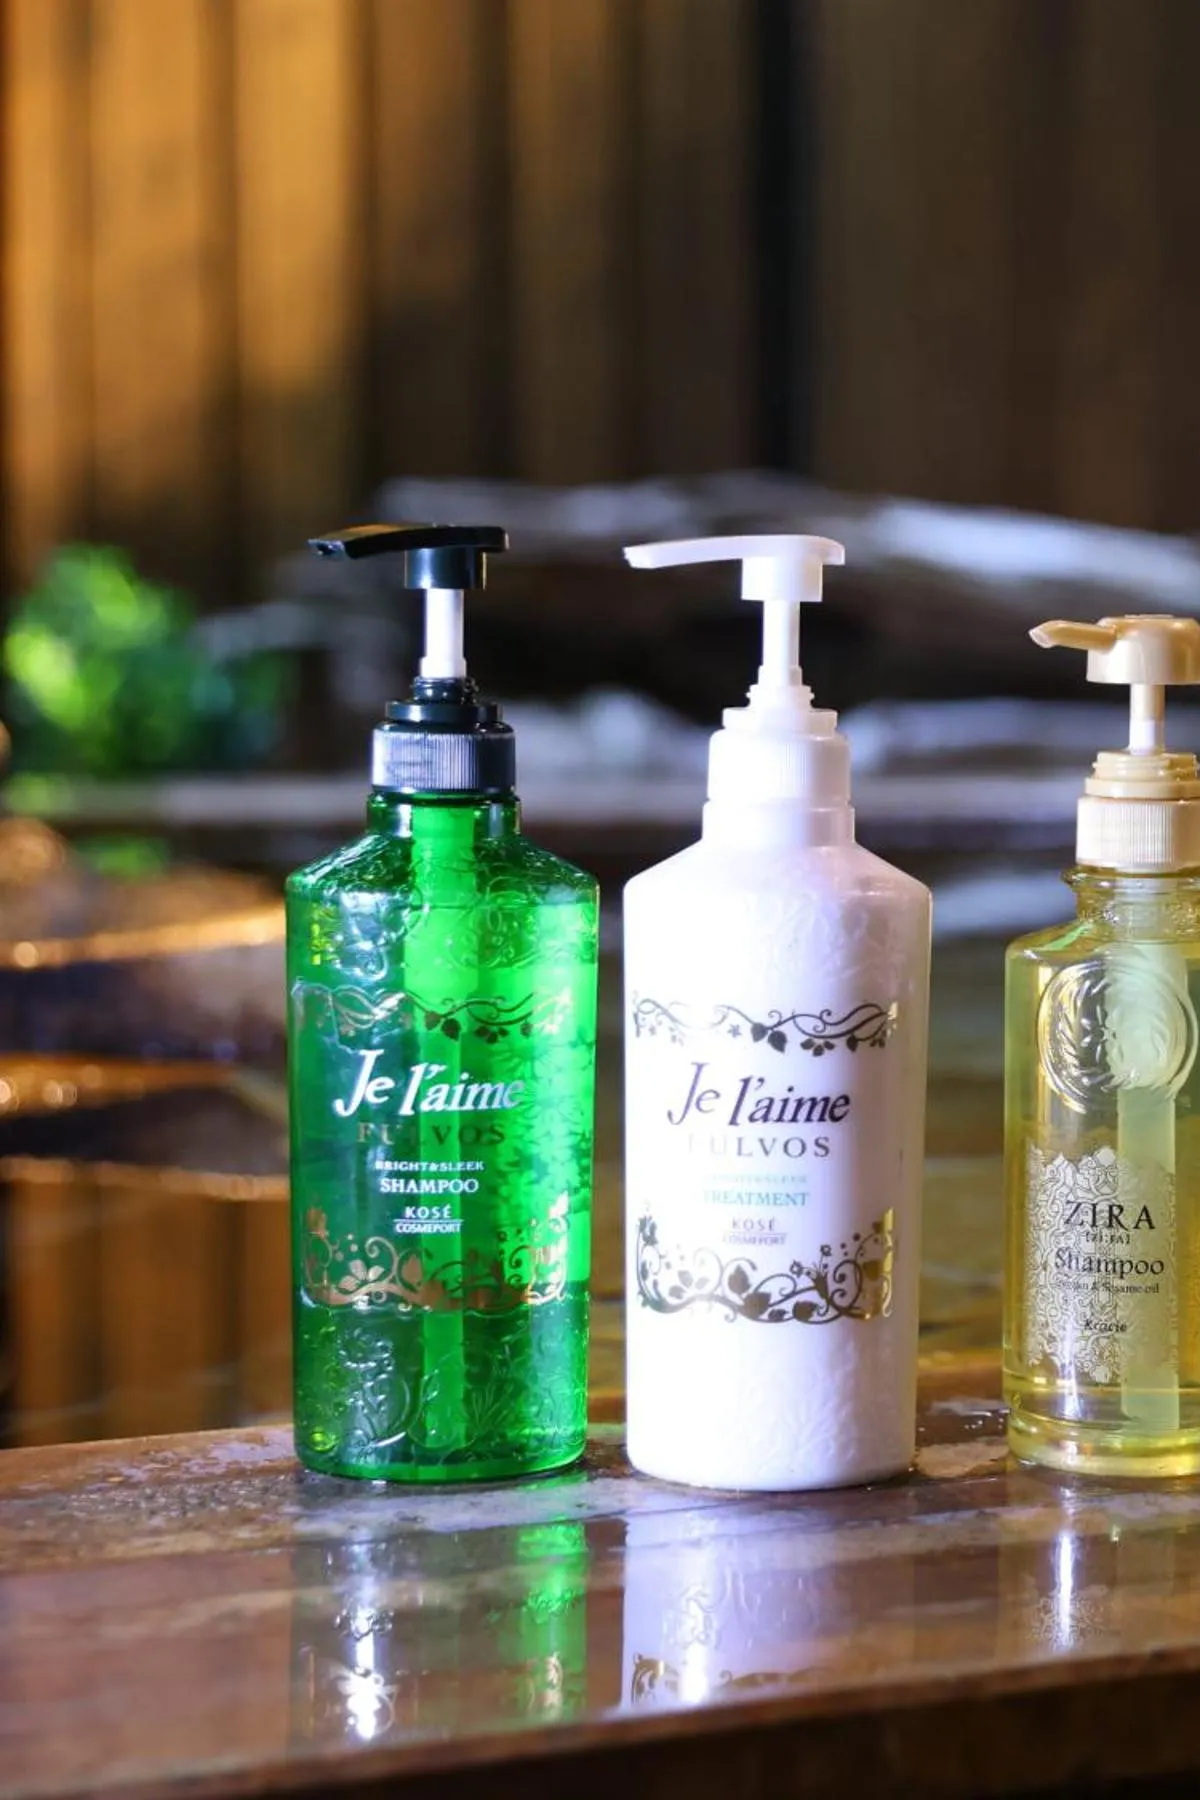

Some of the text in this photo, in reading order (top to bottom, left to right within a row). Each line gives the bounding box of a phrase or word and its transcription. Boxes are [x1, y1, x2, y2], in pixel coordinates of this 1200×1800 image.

[333, 1049, 395, 1117] Je
[667, 1062, 851, 1127] Je l'aime
[357, 1122, 506, 1147] FUVOS
[380, 1178, 479, 1194] SHAMPOO
[704, 1190, 811, 1207] TREATMENT
[405, 1204, 452, 1219] KOSÉ
[1063, 1200, 1156, 1231] ZIRA
[1054, 1247, 1165, 1279] Shampoo
